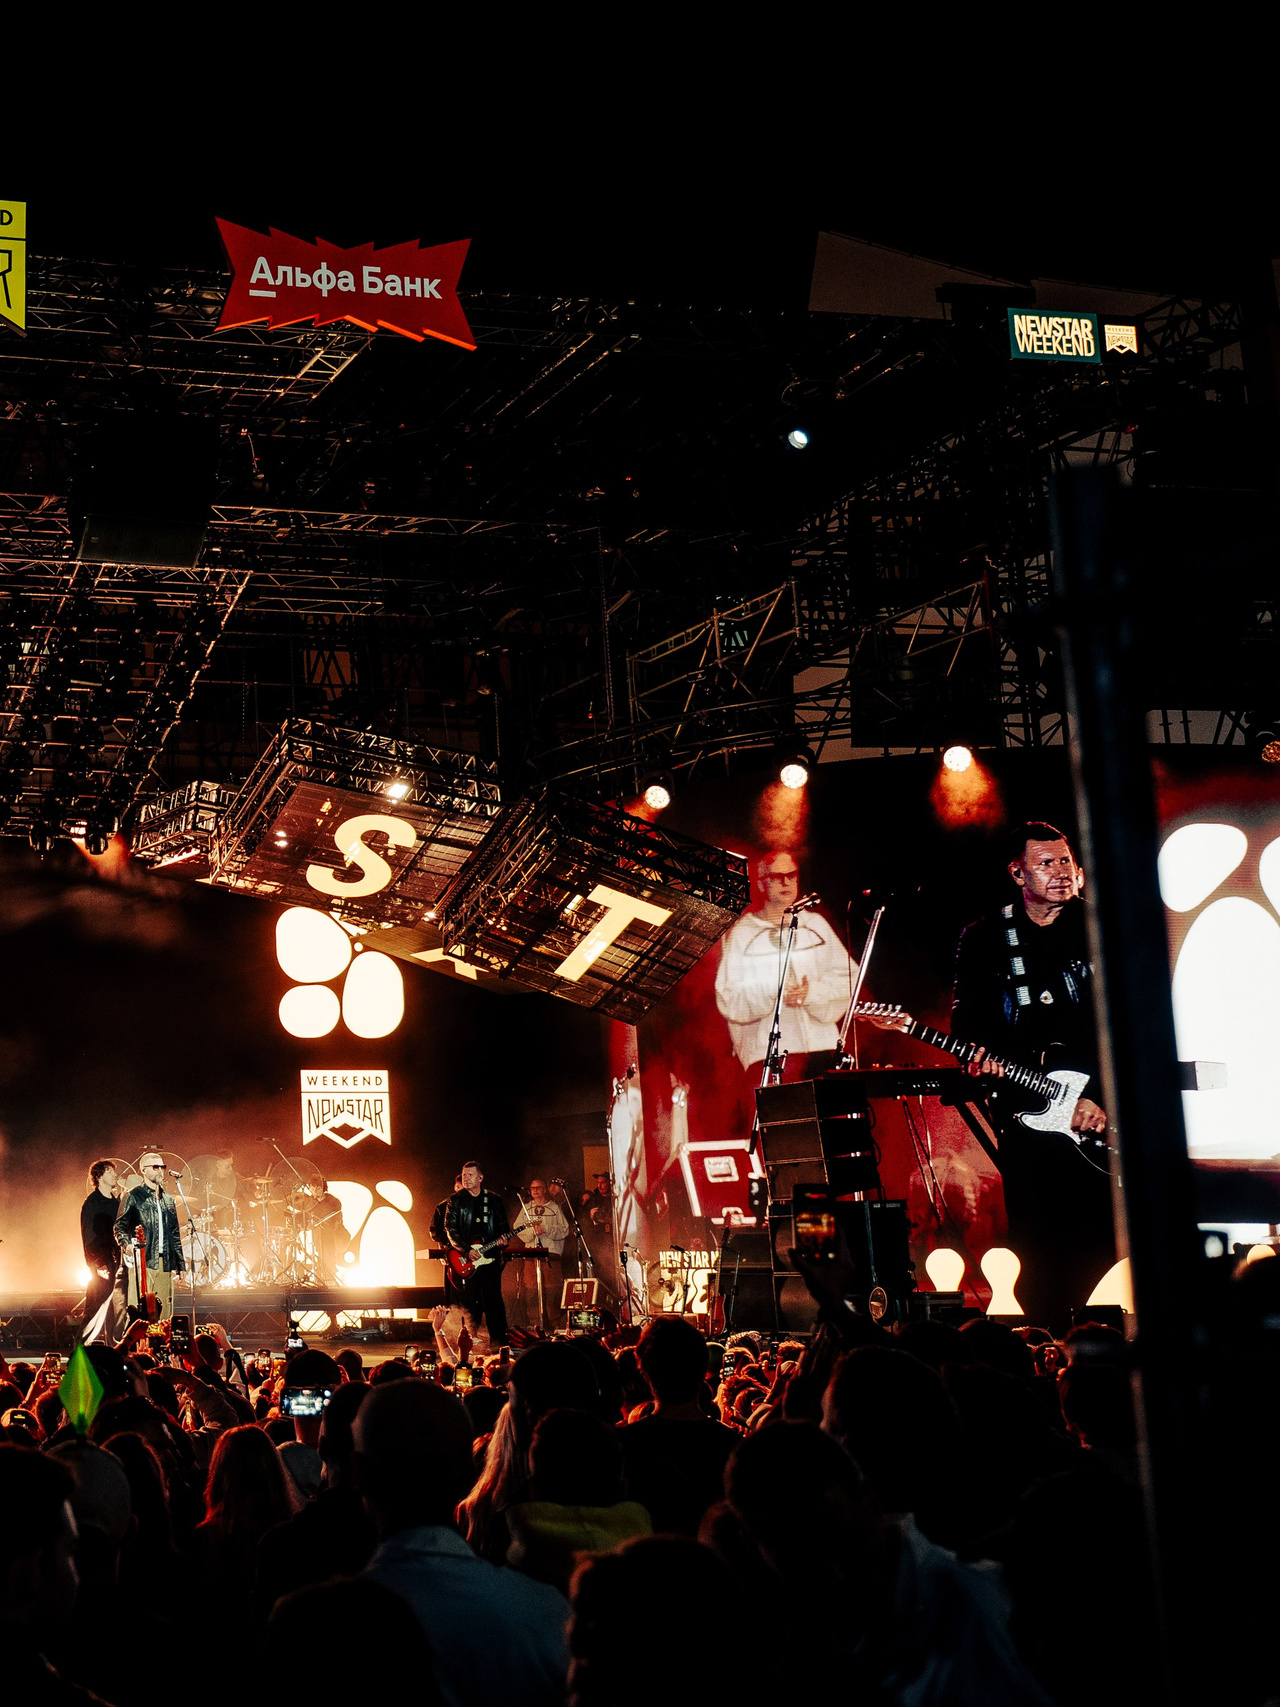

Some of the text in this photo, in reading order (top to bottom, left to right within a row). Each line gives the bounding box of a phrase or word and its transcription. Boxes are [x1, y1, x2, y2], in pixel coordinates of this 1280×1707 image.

[249, 256, 443, 300] Альфа Банк
[1013, 314, 1094, 340] NEWSTAR
[1015, 333, 1095, 357] WEEKEND
[306, 814, 417, 898] S
[553, 884, 672, 982] T
[306, 1075, 383, 1086] WEEKEND
[659, 1250, 682, 1268] NEW
[683, 1250, 710, 1268] STAR
